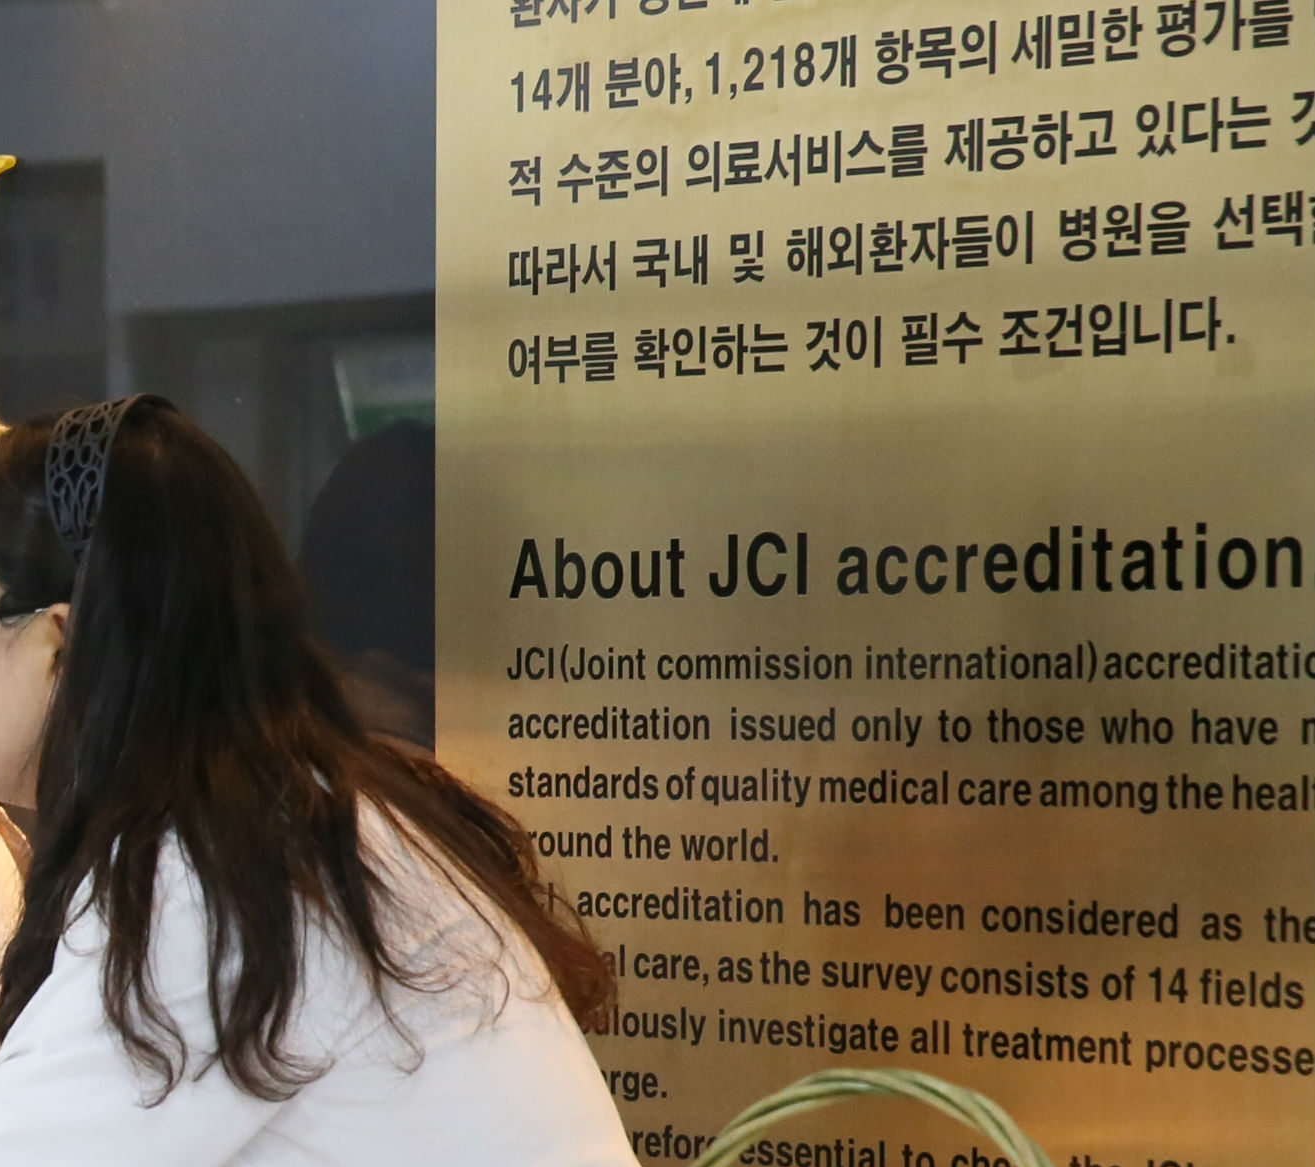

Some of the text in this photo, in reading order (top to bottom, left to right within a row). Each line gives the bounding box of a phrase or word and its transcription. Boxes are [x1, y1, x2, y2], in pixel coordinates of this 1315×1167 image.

[510, 0, 1294, 113] 14개 분야, 1,218개 항목의 세밀한 평가를
[508, 156, 541, 206] 적
[557, 145, 668, 204] 수준의
[685, 123, 928, 193] 의료서비스를
[945, 110, 1117, 172] 제공하고
[1136, 96, 1271, 158] 있다는
[509, 190, 1315, 295] 따라서 국내 및 해외환자들이 병원을 선택
[508, 296, 1235, 385] 여부를 확인하는 것이 필수 조건입니다.
[509, 522, 1303, 600] About JCI accreditation
[657, 645, 852, 681] commission
[508, 706, 710, 742] accreditation
[731, 707, 836, 742] issued
[851, 707, 922, 747] only
[938, 707, 971, 743] to
[988, 708, 1084, 744] those
[1102, 708, 1173, 745] who
[1192, 709, 1278, 746] have
[508, 766, 1315, 814] standards of quality medical care among the heal
[622, 826, 671, 860] the
[681, 828, 779, 863] world.
[577, 886, 784, 924] accreditation
[803, 891, 861, 927] has
[885, 893, 965, 931] been
[981, 899, 1179, 939] considered
[1201, 911, 1243, 943] as
[1264, 906, 1315, 945] the
[633, 951, 709, 987] care,
[717, 955, 754, 986] as
[760, 950, 811, 987] the
[821, 961, 932, 997] survey
[940, 961, 1090, 1001] consists
[1102, 966, 1136, 1002] of
[1149, 967, 1188, 1005] 14
[1200, 968, 1305, 1010] fields
[718, 1008, 899, 1054] investigate
[911, 1019, 950, 1056] all
[964, 1022, 1132, 1066] treatment
